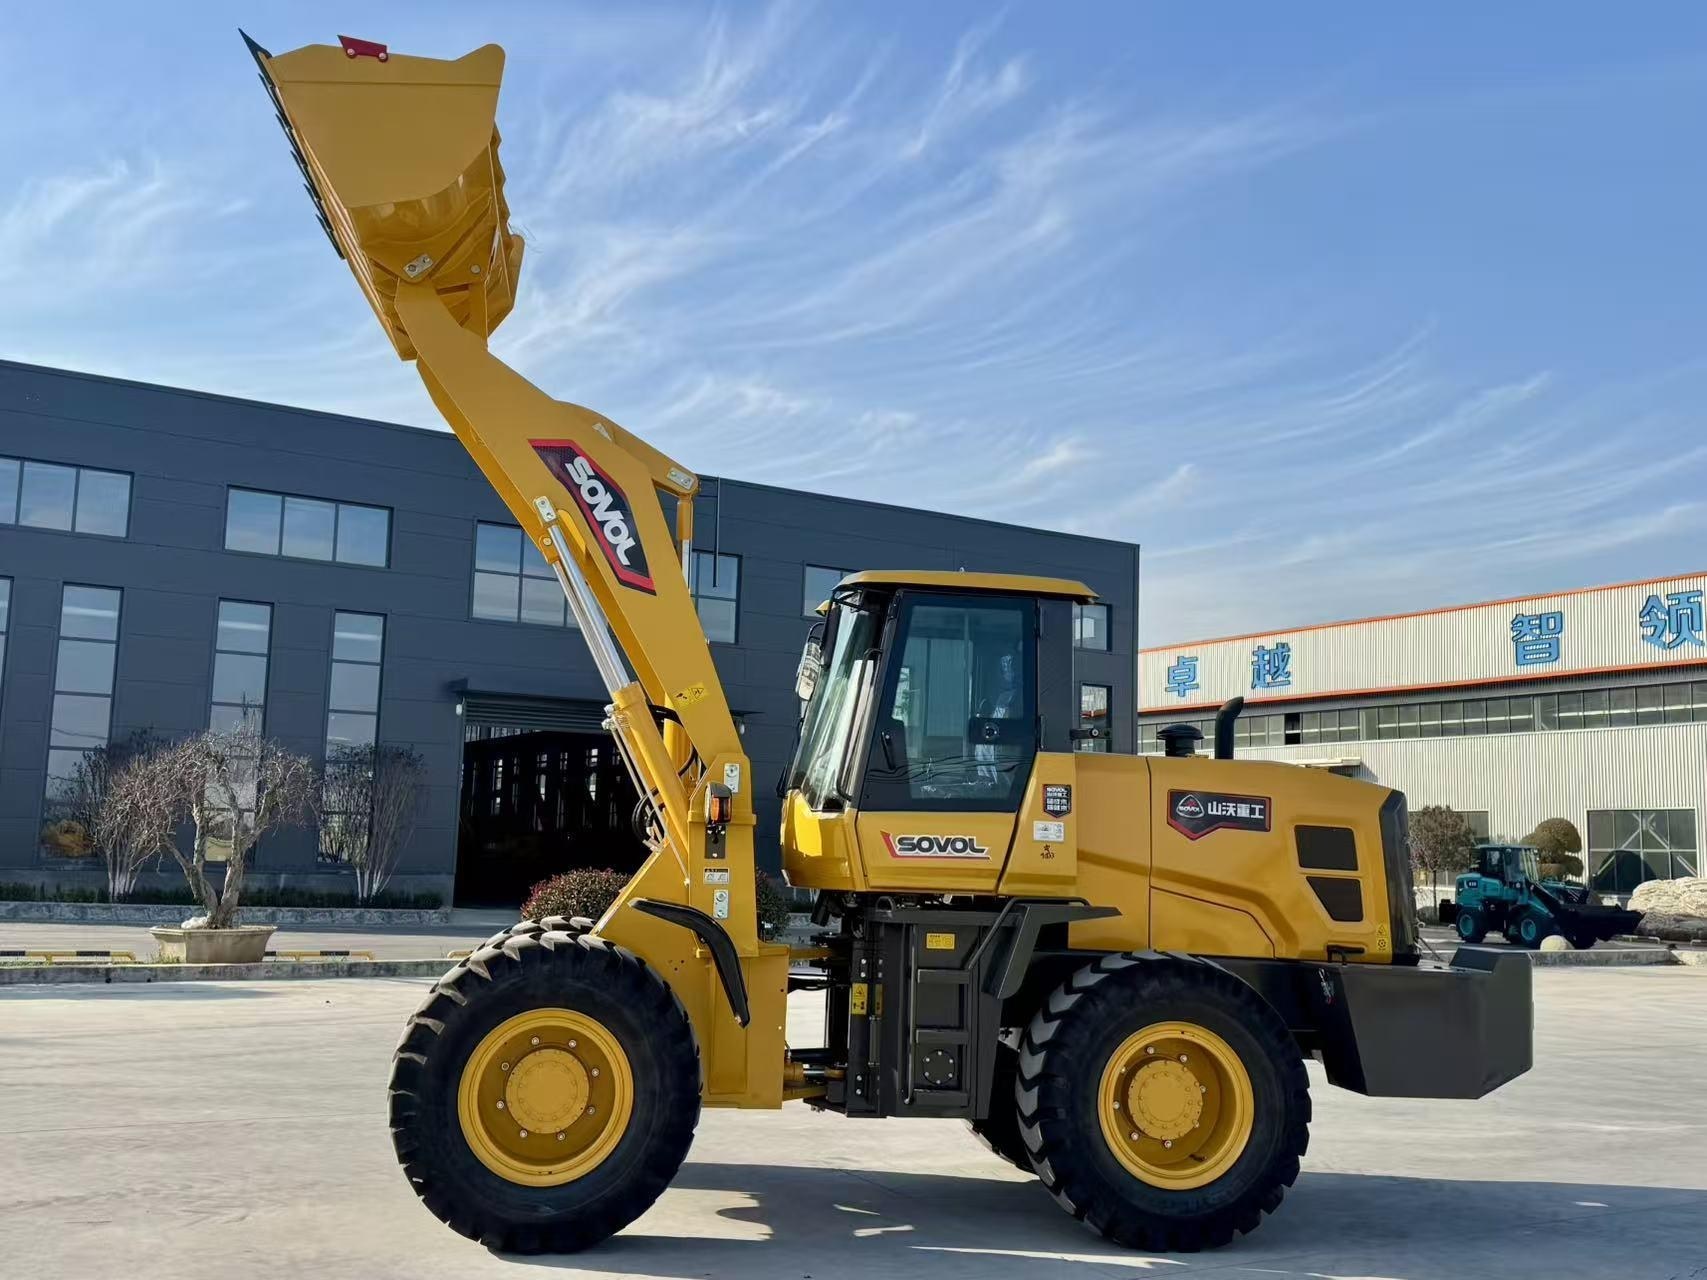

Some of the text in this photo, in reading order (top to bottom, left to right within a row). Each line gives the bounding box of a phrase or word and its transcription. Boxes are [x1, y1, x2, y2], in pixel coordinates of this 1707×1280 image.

[564, 455, 635, 566] SOVOL
[1165, 590, 1705, 697] 卓越 智领
[1207, 801, 1265, 819] 山沃重工
[896, 835, 988, 855] SOVOL
